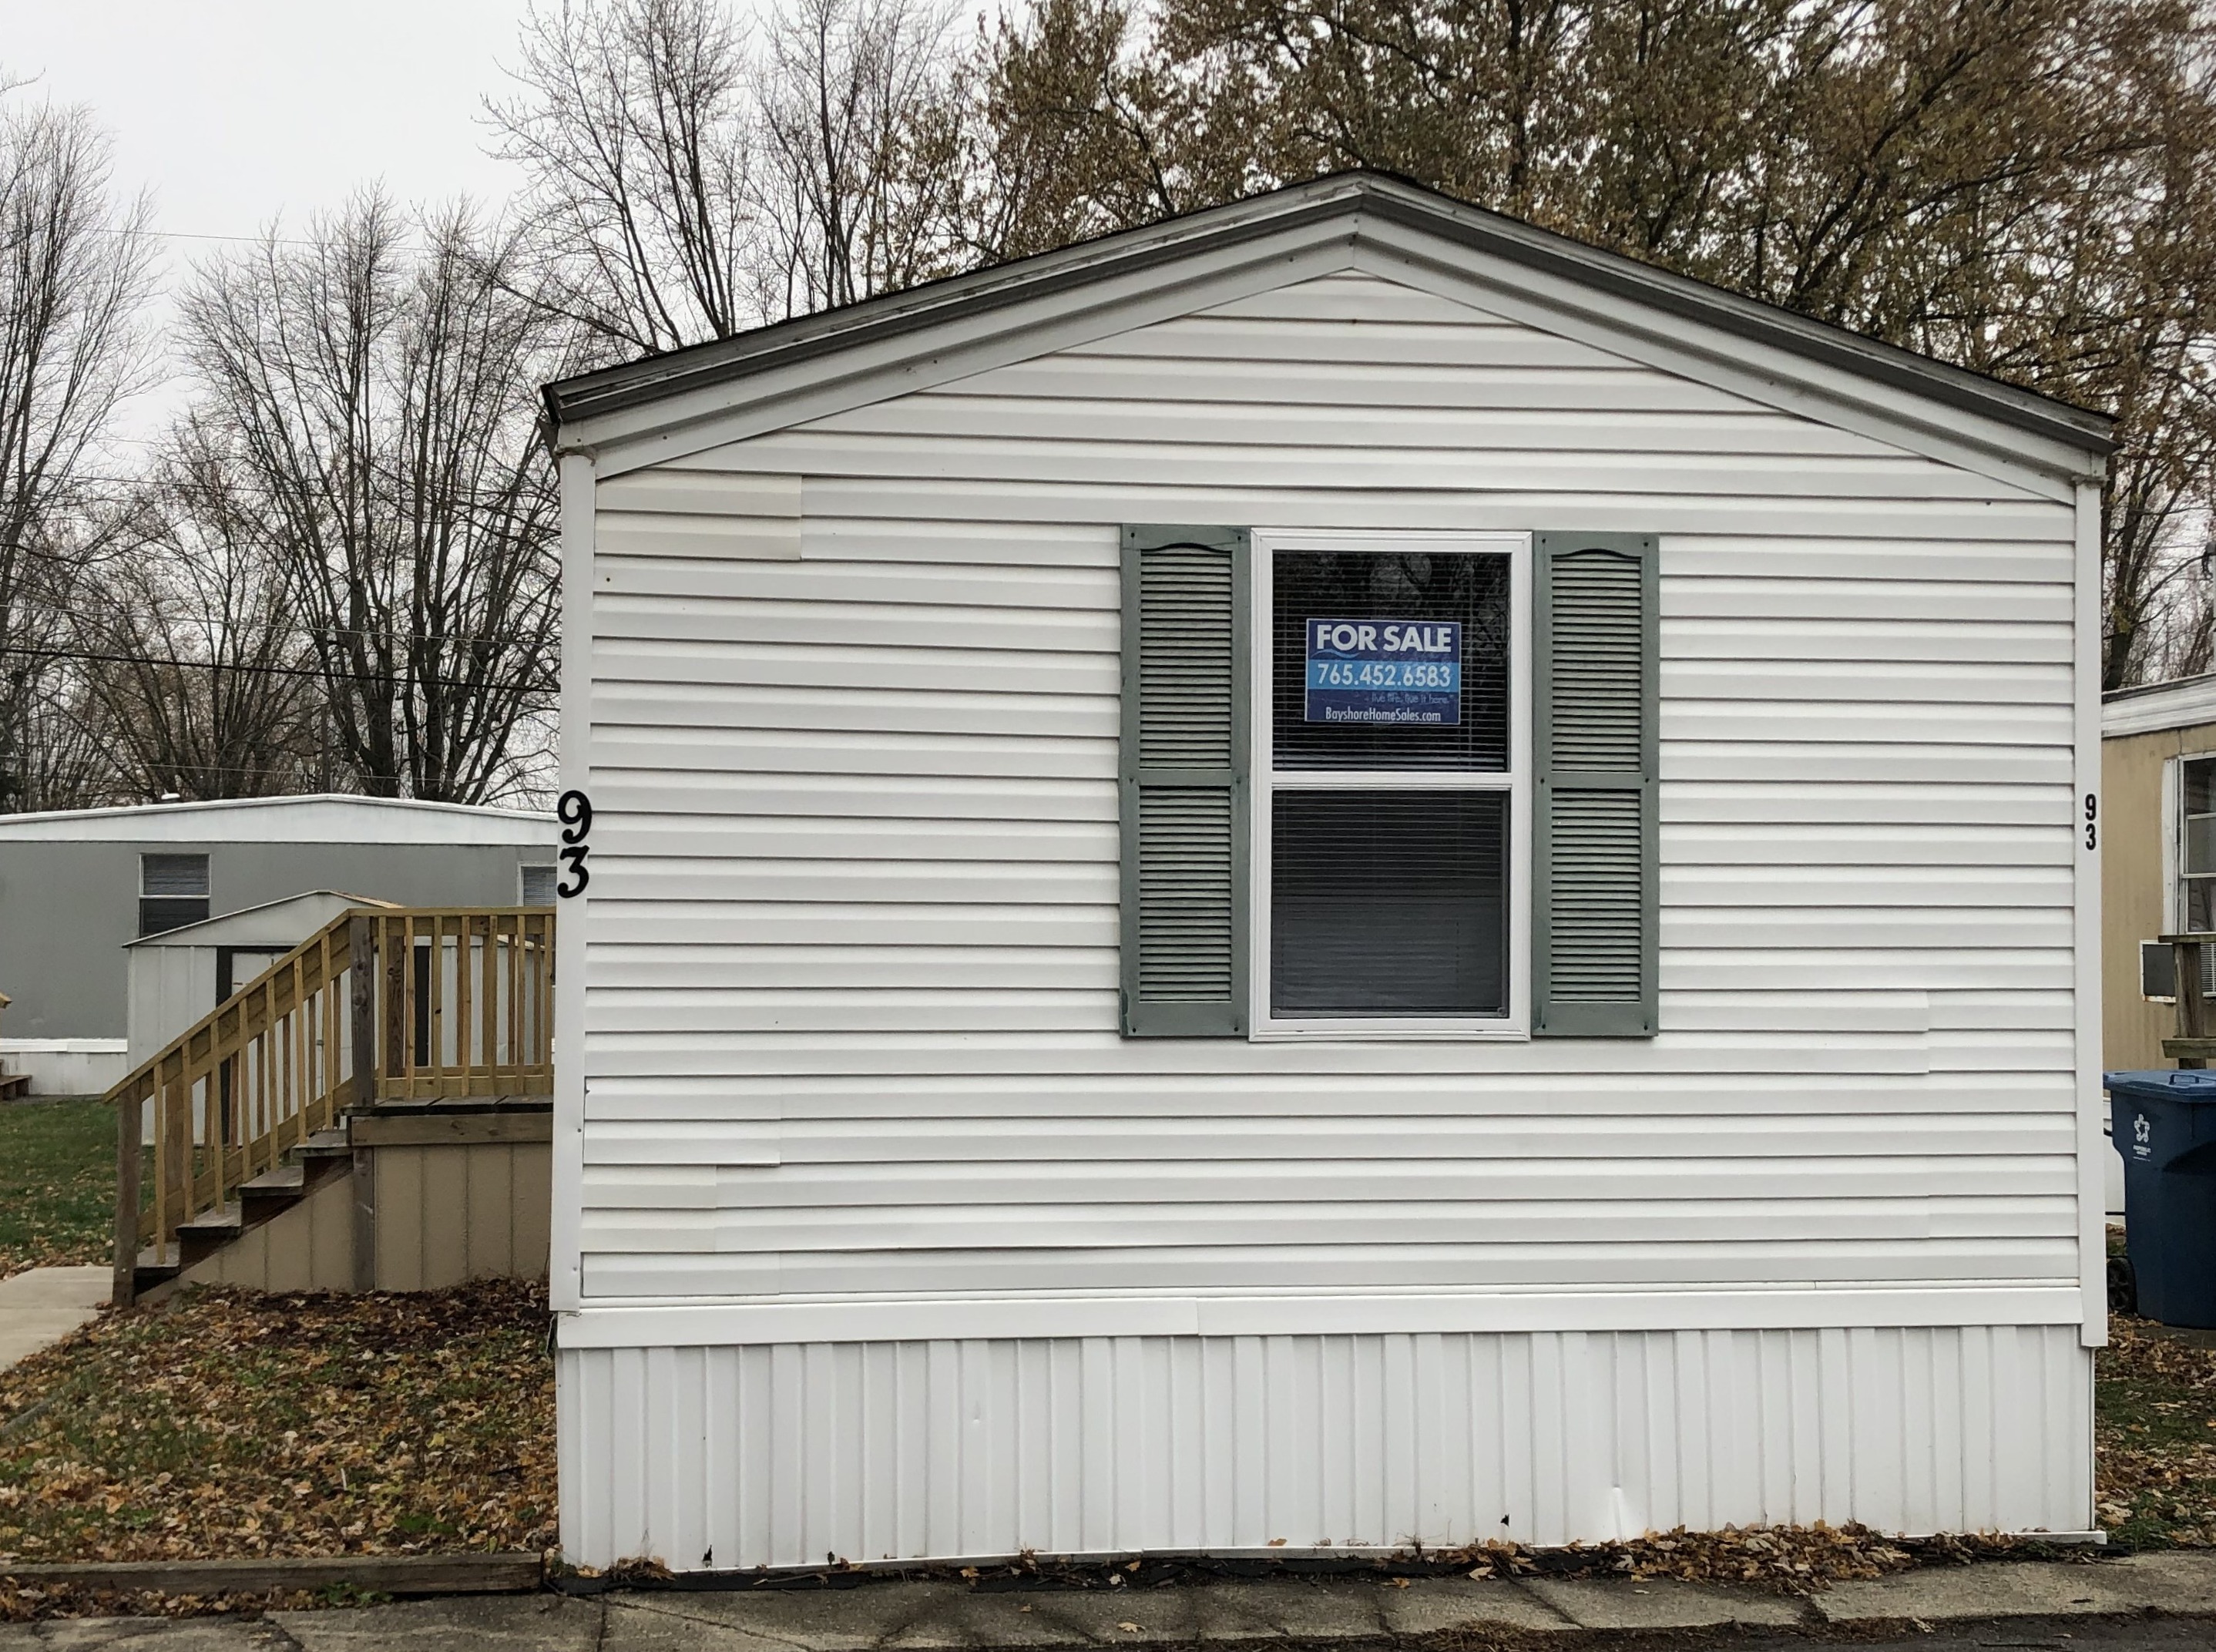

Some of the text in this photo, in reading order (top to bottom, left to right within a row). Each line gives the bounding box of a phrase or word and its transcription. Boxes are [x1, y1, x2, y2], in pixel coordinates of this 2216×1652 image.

[1317, 624, 1452, 653] FOR SALE
[1318, 663, 1451, 687] 765.452.6583
[1325, 706, 1442, 722] BayshoreHomeSales.com
[2085, 794, 2097, 851] 93
[557, 790, 593, 898] 93
